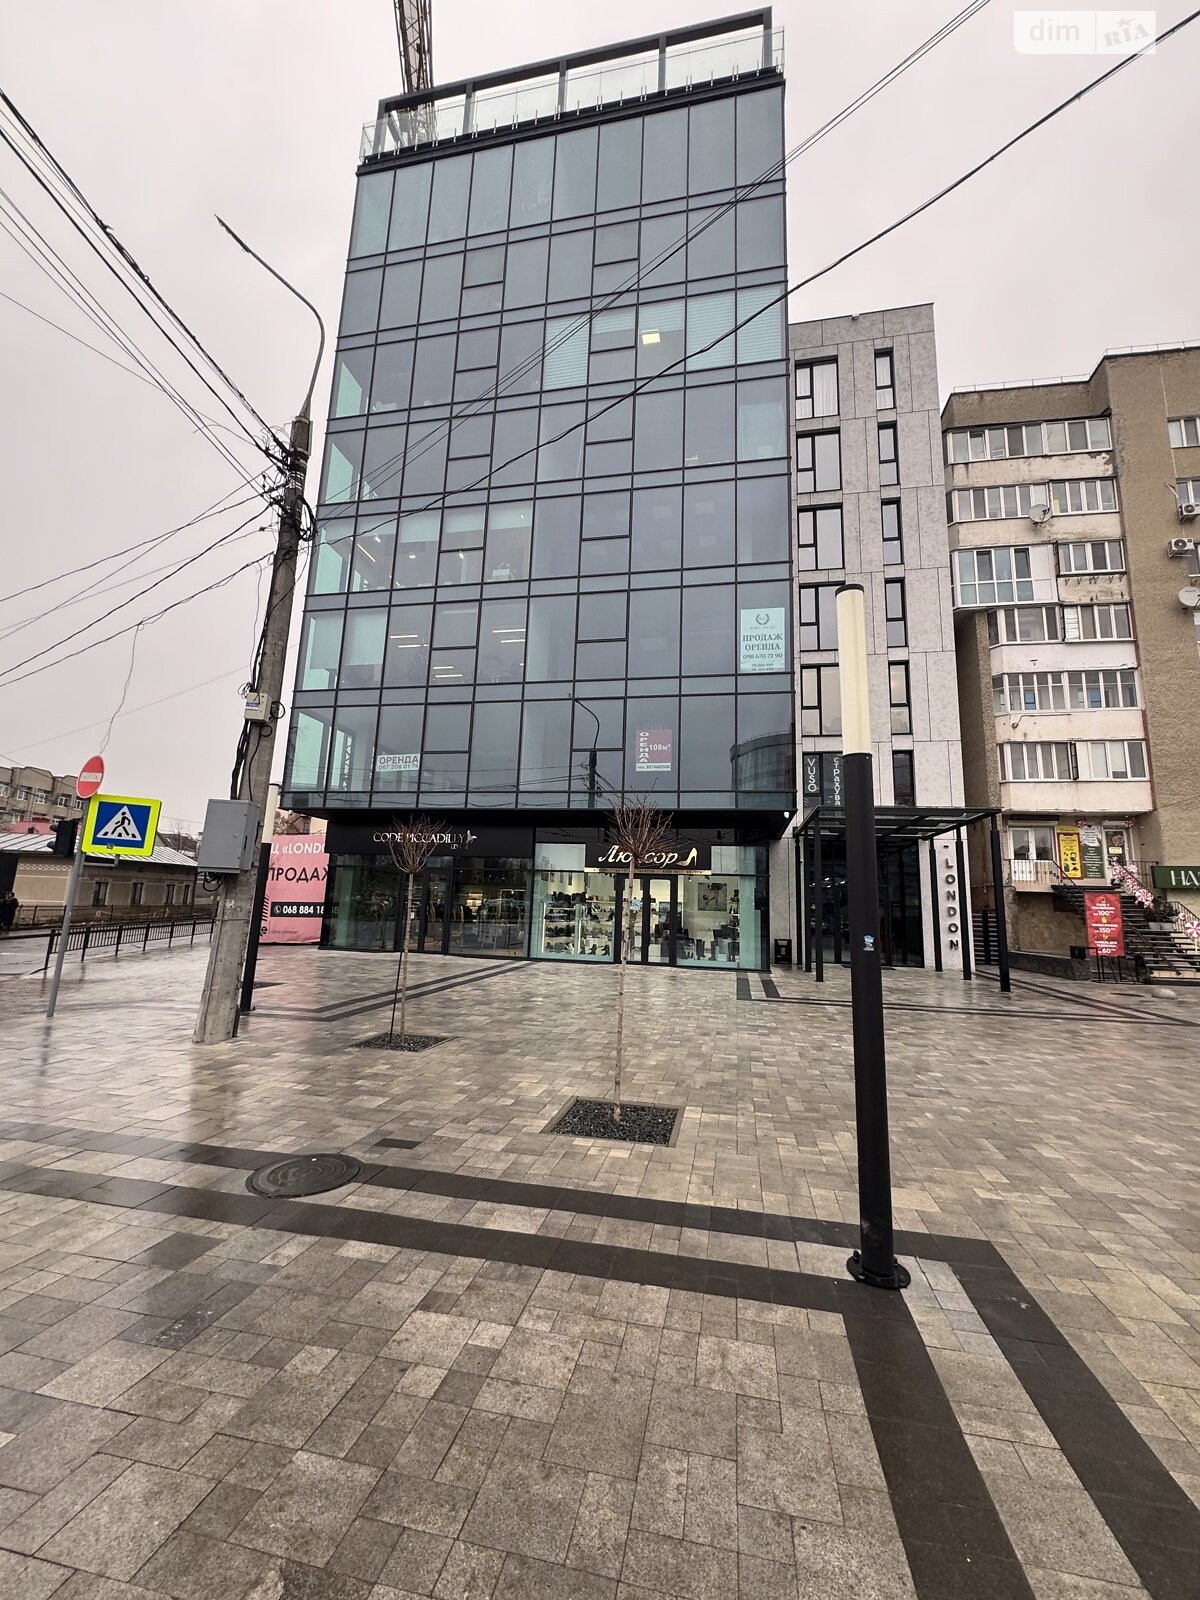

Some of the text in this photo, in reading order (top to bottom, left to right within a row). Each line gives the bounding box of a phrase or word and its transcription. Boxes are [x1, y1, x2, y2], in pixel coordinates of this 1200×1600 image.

[742, 633, 783, 642] ПРОДАЖ
[744, 643, 781, 651] ОРЕНДА
[639, 731, 649, 763] ОРЕНДА
[379, 756, 419, 764] ОРЕНДА
[807, 758, 817, 792] VUSO
[833, 757, 841, 806] страхува
[373, 832, 404, 843] CODE
[598, 844, 679, 869] Люсор
[1170, 870, 1200, 886] НА
[282, 905, 298, 914] 068
[298, 905, 314, 914] 884
[944, 857, 959, 951] LONDON
